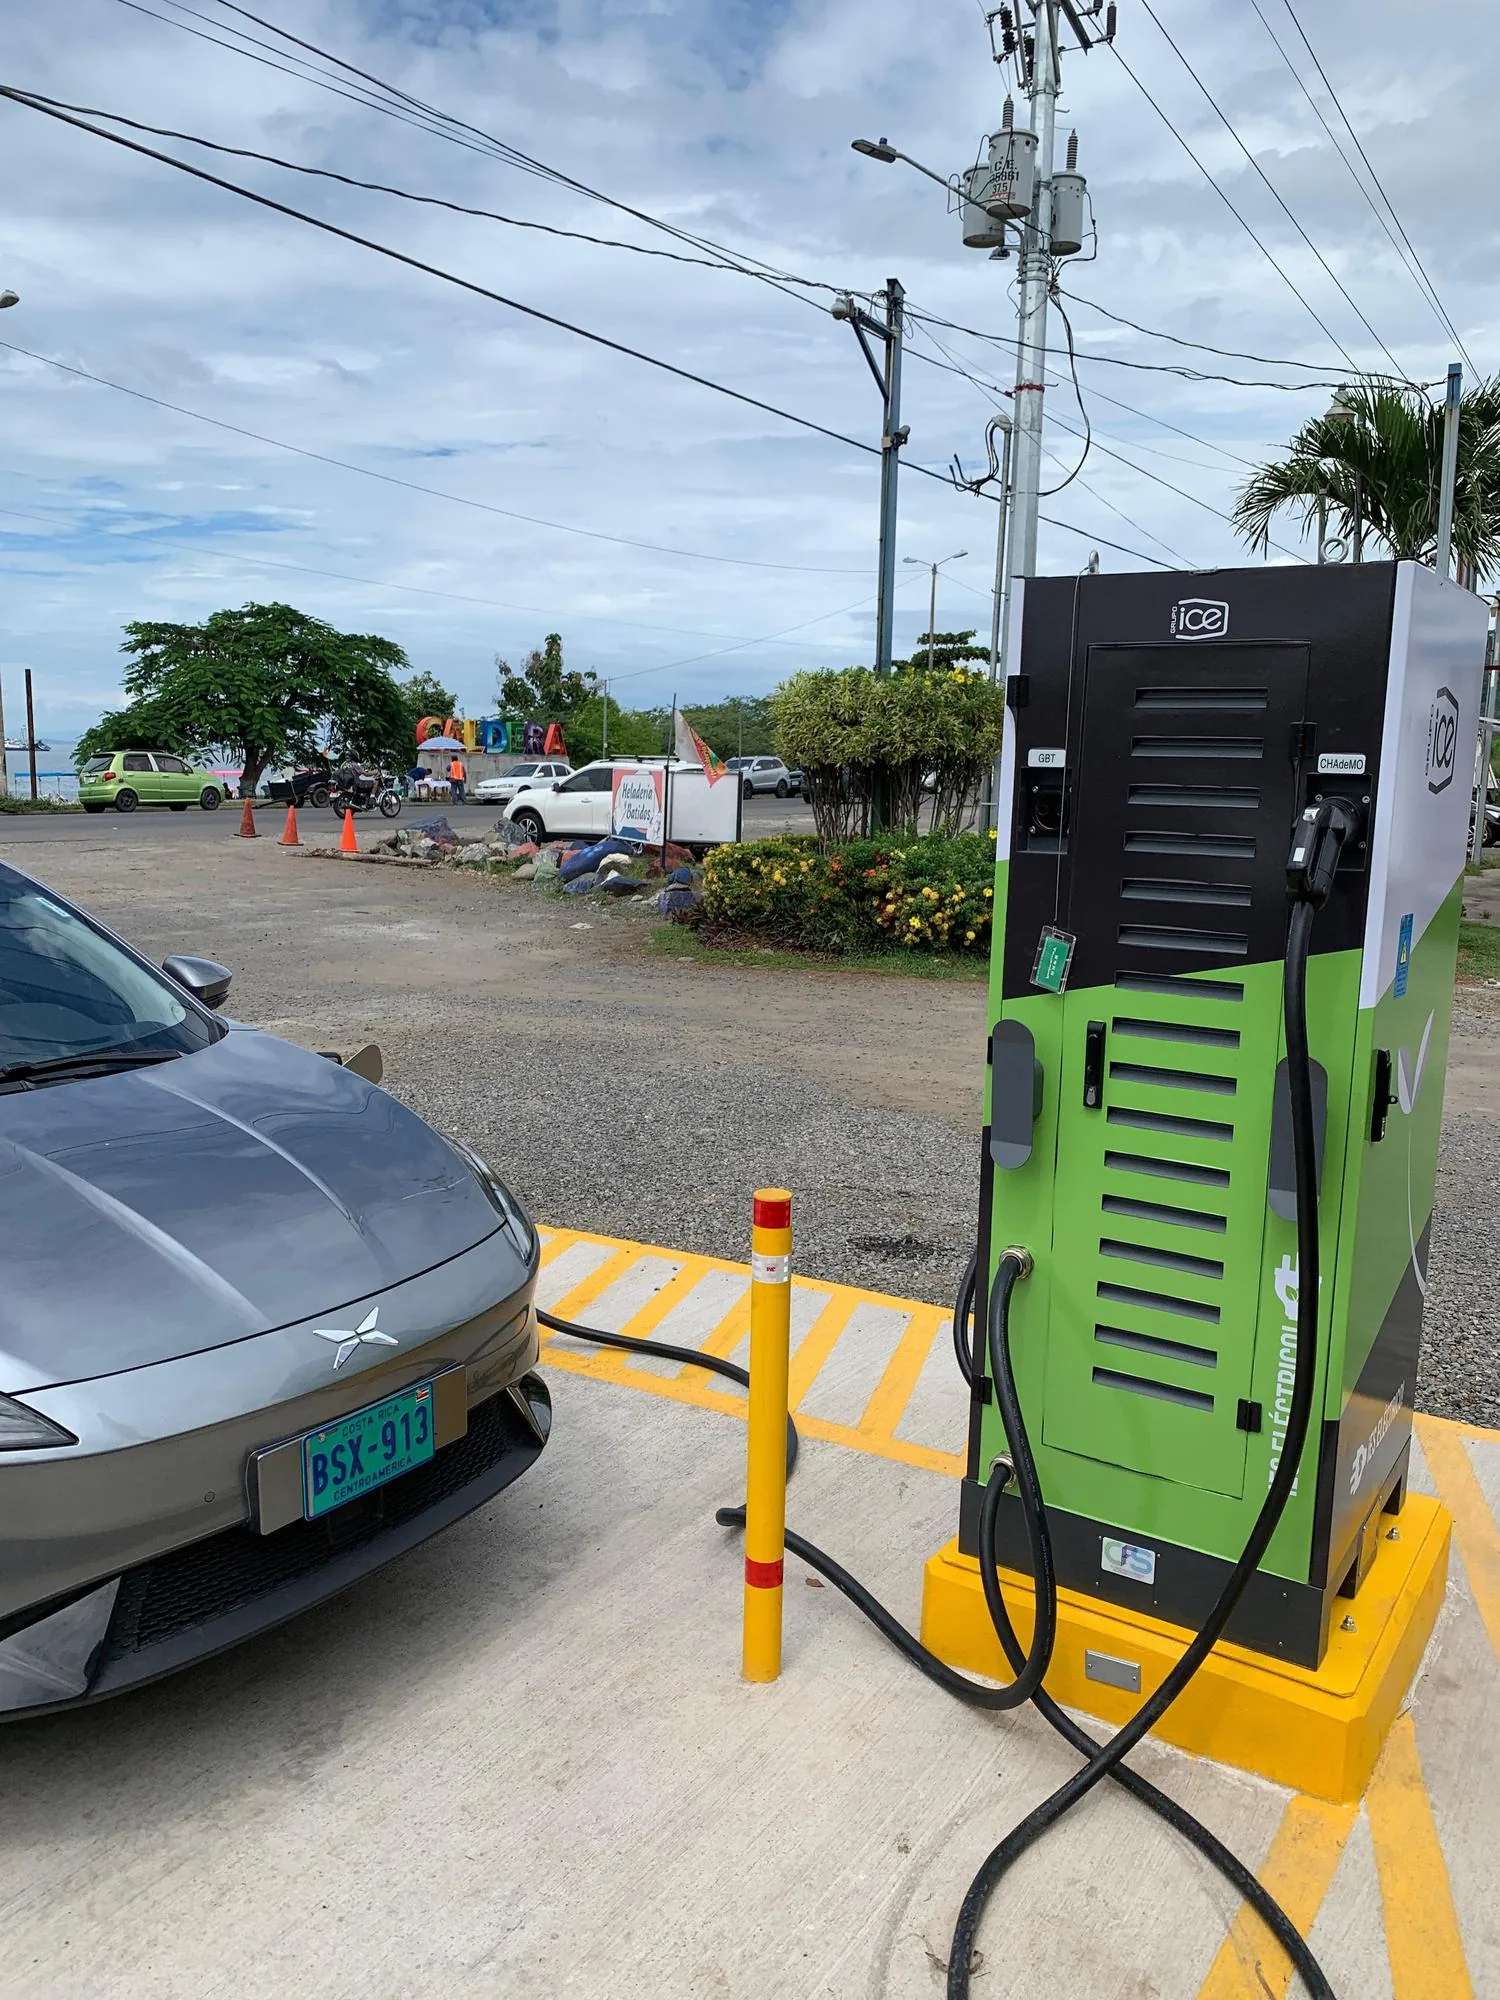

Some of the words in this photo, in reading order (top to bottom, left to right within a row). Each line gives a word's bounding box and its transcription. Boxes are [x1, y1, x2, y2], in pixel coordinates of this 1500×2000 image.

[1170, 606, 1178, 634] GRUPO
[1179, 607, 1222, 630] ice
[416, 716, 568, 755] CALDERA
[1432, 707, 1455, 769] ice
[1038, 753, 1056, 764] GBT
[1320, 758, 1364, 770] CHAdeMO
[342, 1415, 374, 1438] COSTA
[378, 1403, 400, 1420] RICA
[312, 1405, 428, 1497] BSX-913
[333, 1455, 413, 1501] CENTROAMERICA
